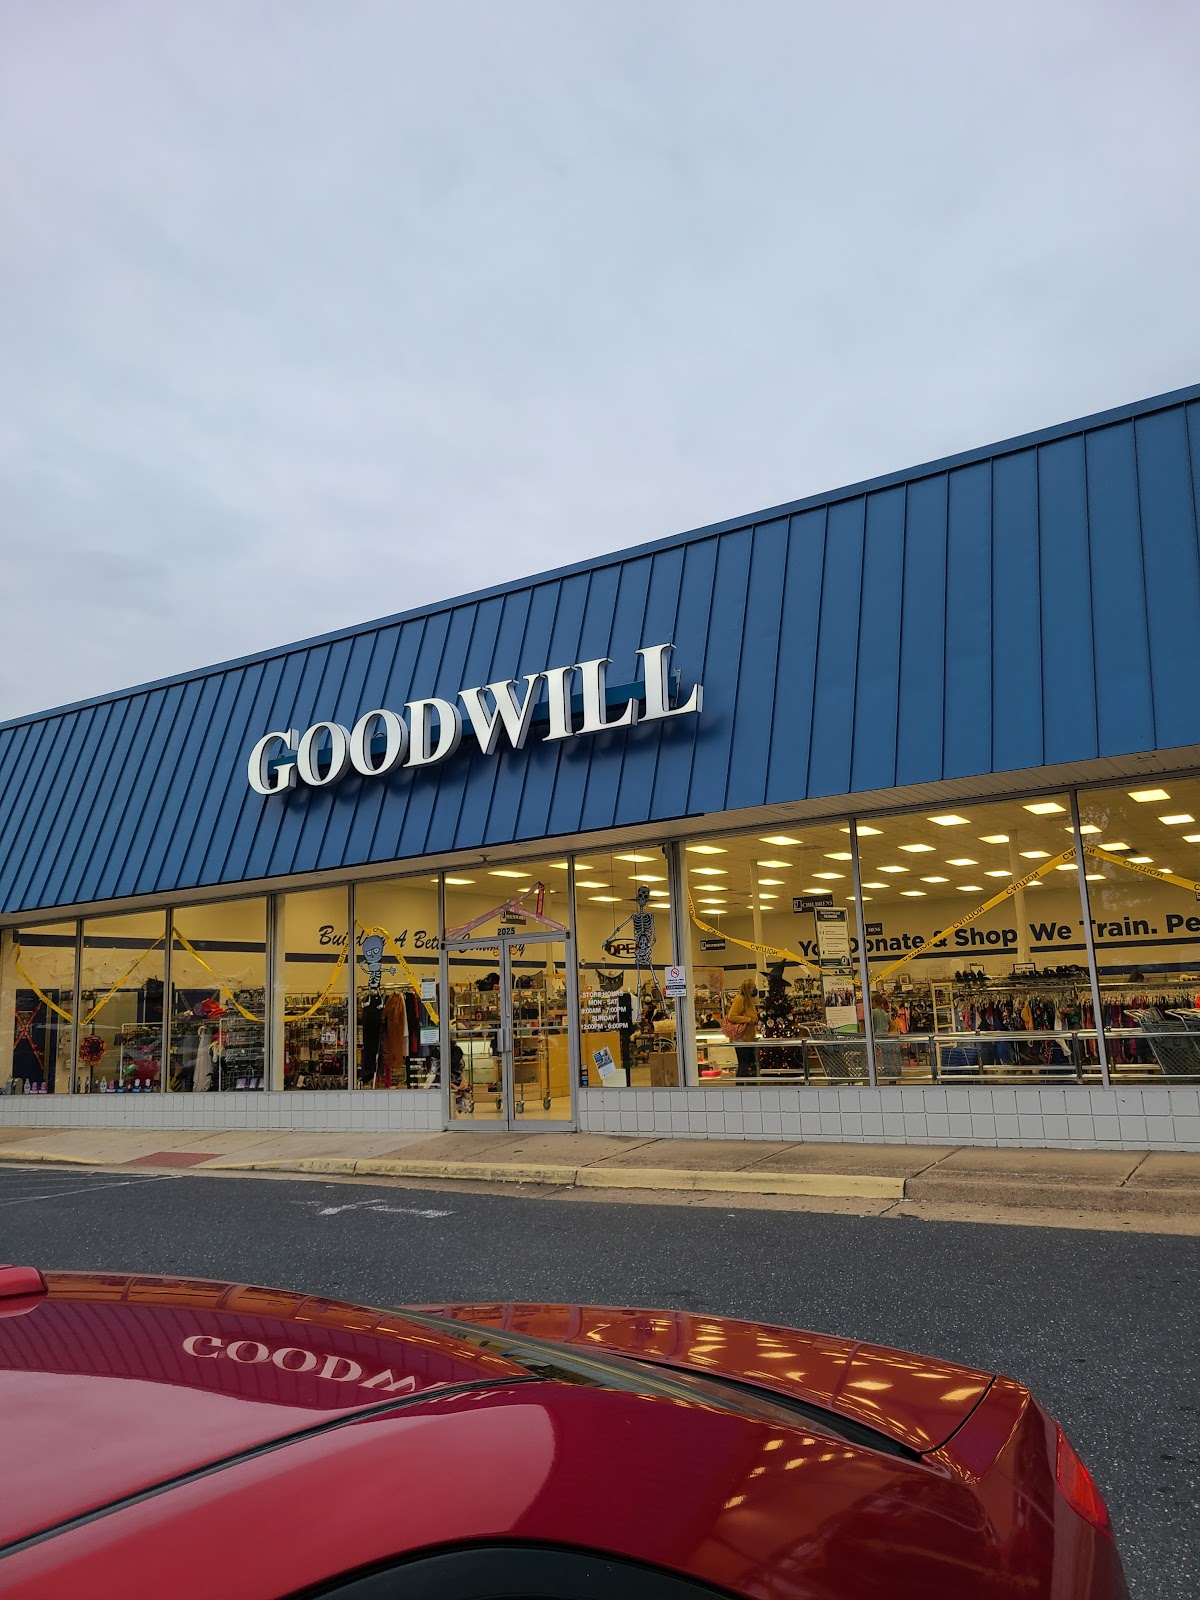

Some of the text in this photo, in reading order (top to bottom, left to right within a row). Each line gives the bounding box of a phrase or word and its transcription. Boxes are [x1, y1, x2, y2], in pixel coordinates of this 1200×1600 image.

[247, 642, 703, 795] GOODWILL
[394, 929, 408, 948] A
[497, 927, 515, 936] 2025
[1029, 922, 1072, 942] We
[608, 943, 640, 955] OPE
[582, 991, 601, 999] STORE
